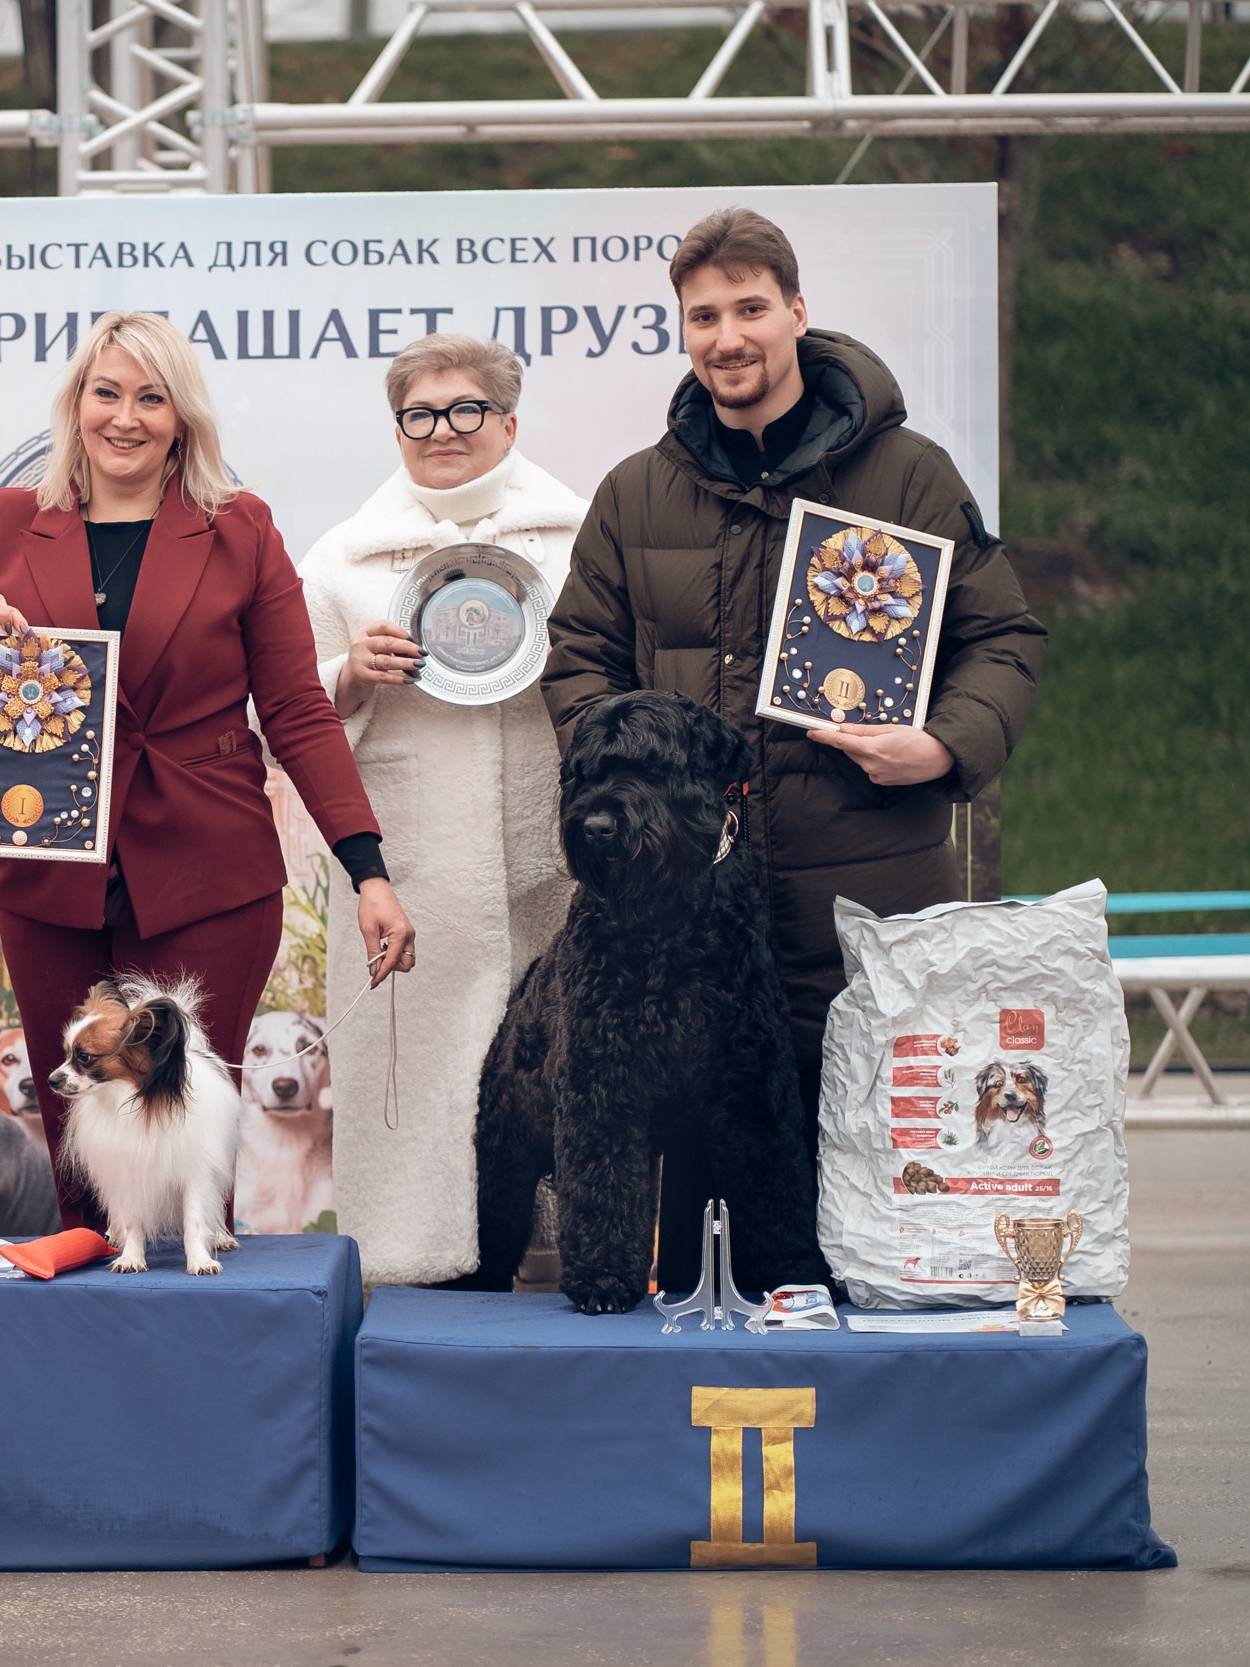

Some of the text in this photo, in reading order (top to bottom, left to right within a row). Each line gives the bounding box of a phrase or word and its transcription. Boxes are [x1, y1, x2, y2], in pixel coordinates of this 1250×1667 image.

[208, 239, 290, 273] ДЛЯ
[305, 236, 440, 267] СОБАК
[455, 236, 558, 265] ВСЕХ
[573, 233, 682, 263] ПОРО
[491, 304, 687, 367] ДРУЗ
[1005, 1010, 1039, 1034] Clan
[1006, 1036, 1037, 1045] classic
[970, 1181, 1004, 1191] Active
[1005, 1183, 1033, 1192] adult
[690, 1385, 818, 1569] II
